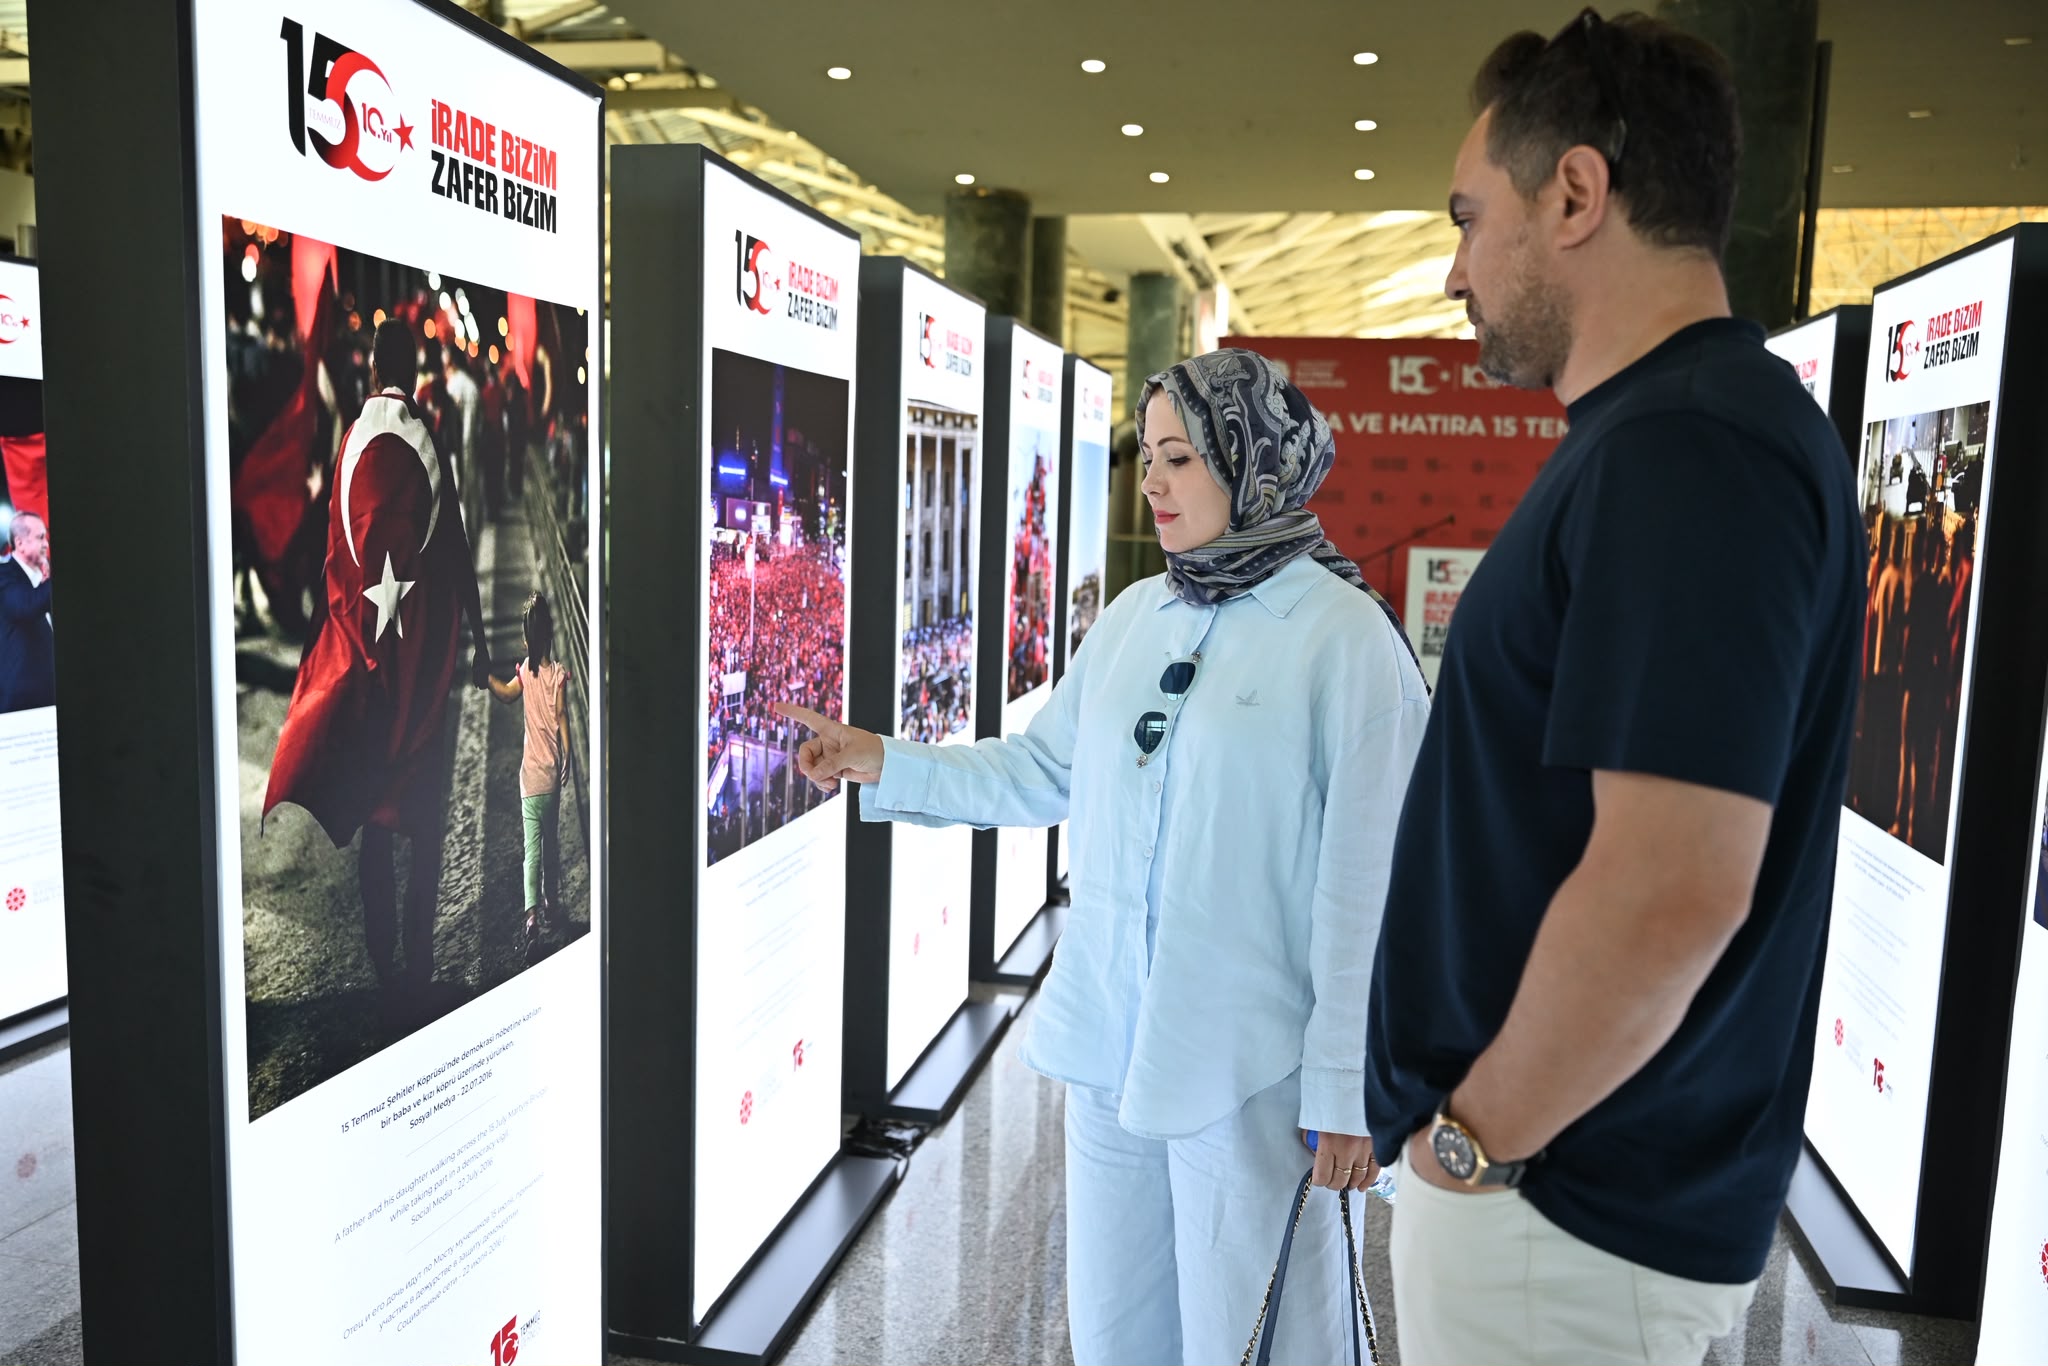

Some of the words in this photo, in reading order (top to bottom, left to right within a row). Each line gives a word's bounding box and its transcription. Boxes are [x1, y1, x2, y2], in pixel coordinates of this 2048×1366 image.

[280, 16, 364, 174] 15
[431, 98, 496, 168] İRADE
[502, 130, 557, 191] BİZİM
[431, 150, 498, 216] ZAFER
[503, 170, 557, 234] BİZİM
[788, 291, 814, 324] ZAFER
[1953, 300, 1983, 334] BİZİM
[1923, 340, 1951, 370] ZAFER
[1951, 331, 1980, 362] BİZİM
[1350, 413, 1384, 434] VE
[1390, 413, 1487, 437] HATIRA
[1493, 416, 1518, 438] 15
[1523, 416, 1569, 439] TEM
[341, 1121, 350, 1134] 15
[351, 1101, 386, 1128] Temmuz
[386, 1083, 416, 1108] Şehitler
[461, 1033, 495, 1061] demokrasi
[380, 1116, 392, 1129] bir
[392, 1105, 412, 1121] baba
[412, 1098, 422, 1109] ve
[422, 1089, 435, 1103] kızı
[436, 1074, 456, 1094] köprü
[457, 1058, 485, 1081] üzerinde
[409, 1107, 432, 1129] Sosyal
[433, 1094, 457, 1114] Medya
[461, 1069, 493, 1096] 22.07.2016
[334, 1232, 341, 1245] A
[342, 1215, 366, 1238] father
[367, 1201, 383, 1220] and
[383, 1195, 395, 1208] his
[395, 1171, 429, 1200] daughter
[430, 1152, 456, 1176] walking
[456, 1136, 477, 1156] across
[477, 1129, 488, 1141] the
[495, 1115, 507, 1129] July
[389, 1203, 410, 1222] while
[410, 1186, 433, 1207] taking
[433, 1174, 448, 1192] part
[448, 1169, 456, 1179] in
[456, 1165, 461, 1174] a
[461, 1142, 496, 1170] democracy
[410, 1203, 431, 1226] Social
[432, 1189, 453, 1209] Media
[457, 1177, 466, 1191] 22
[465, 1169, 479, 1184] July
[479, 1156, 494, 1174] 2016
[343, 1319, 364, 1340] Отец
[364, 1313, 371, 1323] и
[371, 1302, 385, 1317] его
[385, 1287, 405, 1307] дочь
[405, 1271, 422, 1290] идут
[422, 1263, 433, 1276] по
[433, 1245, 455, 1268] Мосту
[379, 1301, 409, 1333] участие
[409, 1295, 415, 1305] в
[415, 1264, 452, 1301] дежурстве
[452, 1259, 458, 1268] в
[458, 1239, 482, 1264] защиту
[396, 1290, 442, 1332] Социальные
[442, 1276, 458, 1294] сети
[462, 1264, 470, 1278] 22
